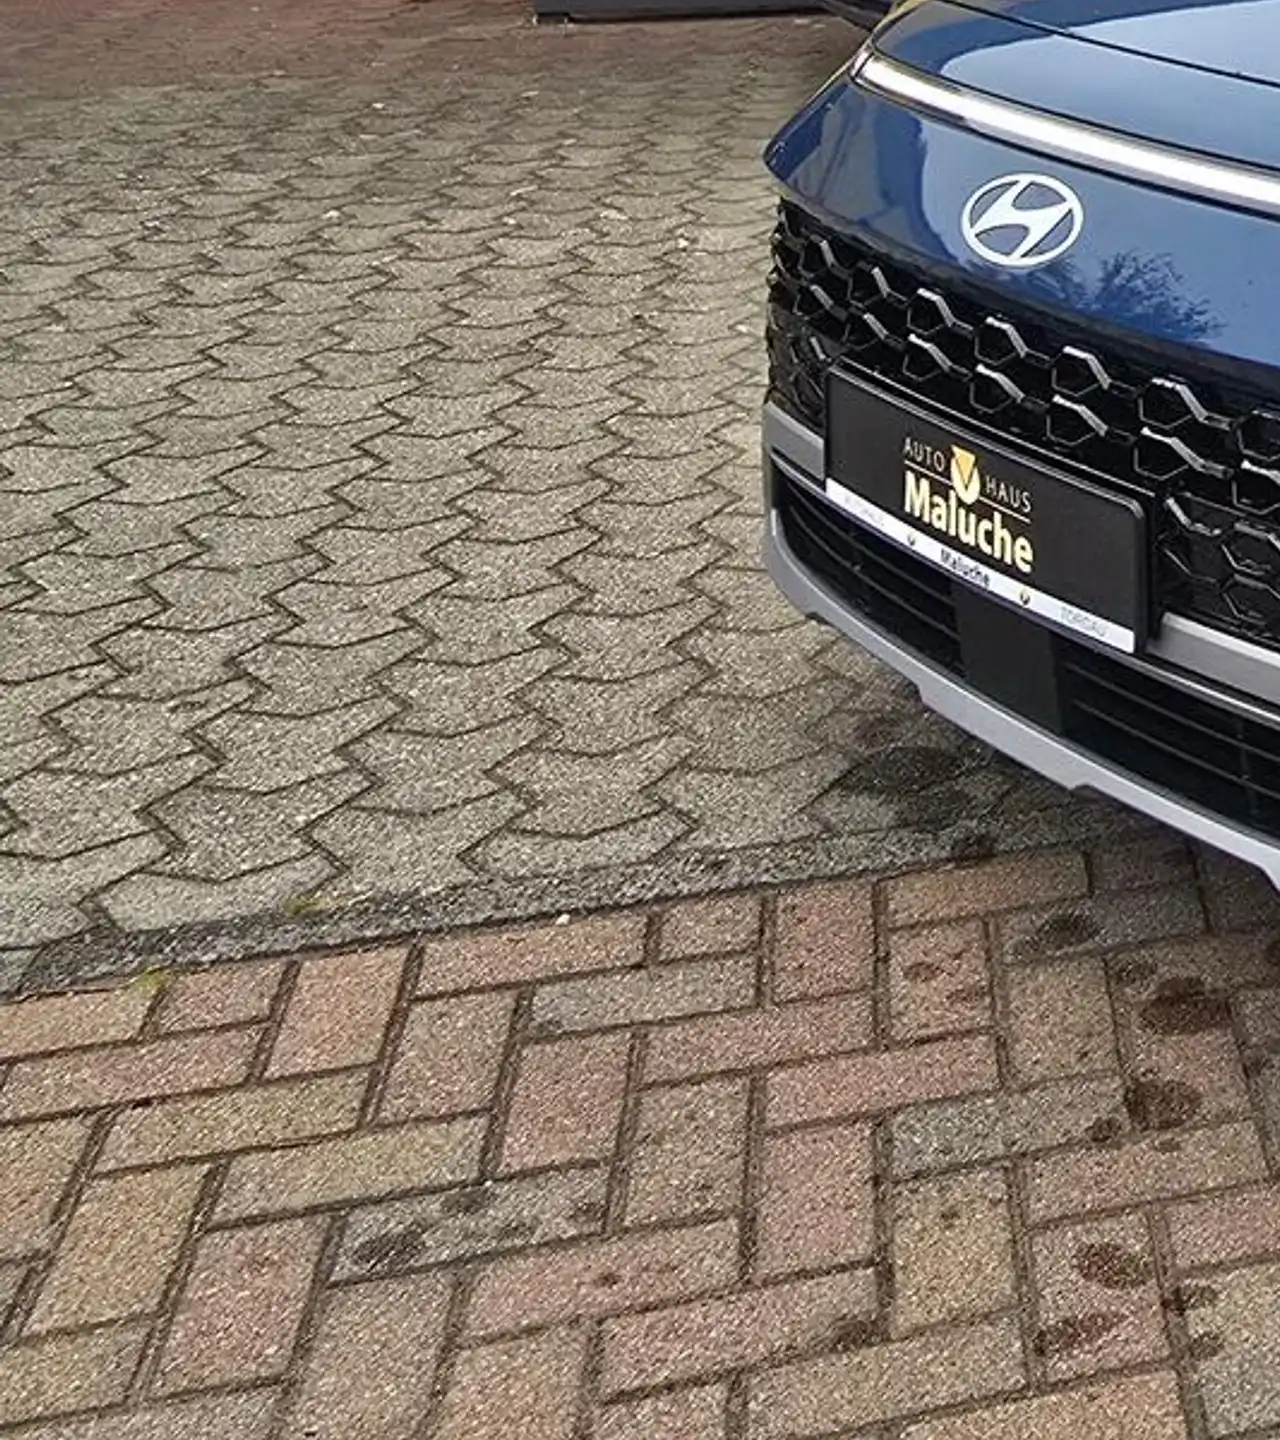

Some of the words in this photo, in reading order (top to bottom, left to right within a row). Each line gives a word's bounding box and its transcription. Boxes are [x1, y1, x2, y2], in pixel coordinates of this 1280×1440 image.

[903, 437, 946, 472] AUTO
[985, 475, 1032, 513] HAUS
[904, 469, 1034, 574] Maluche
